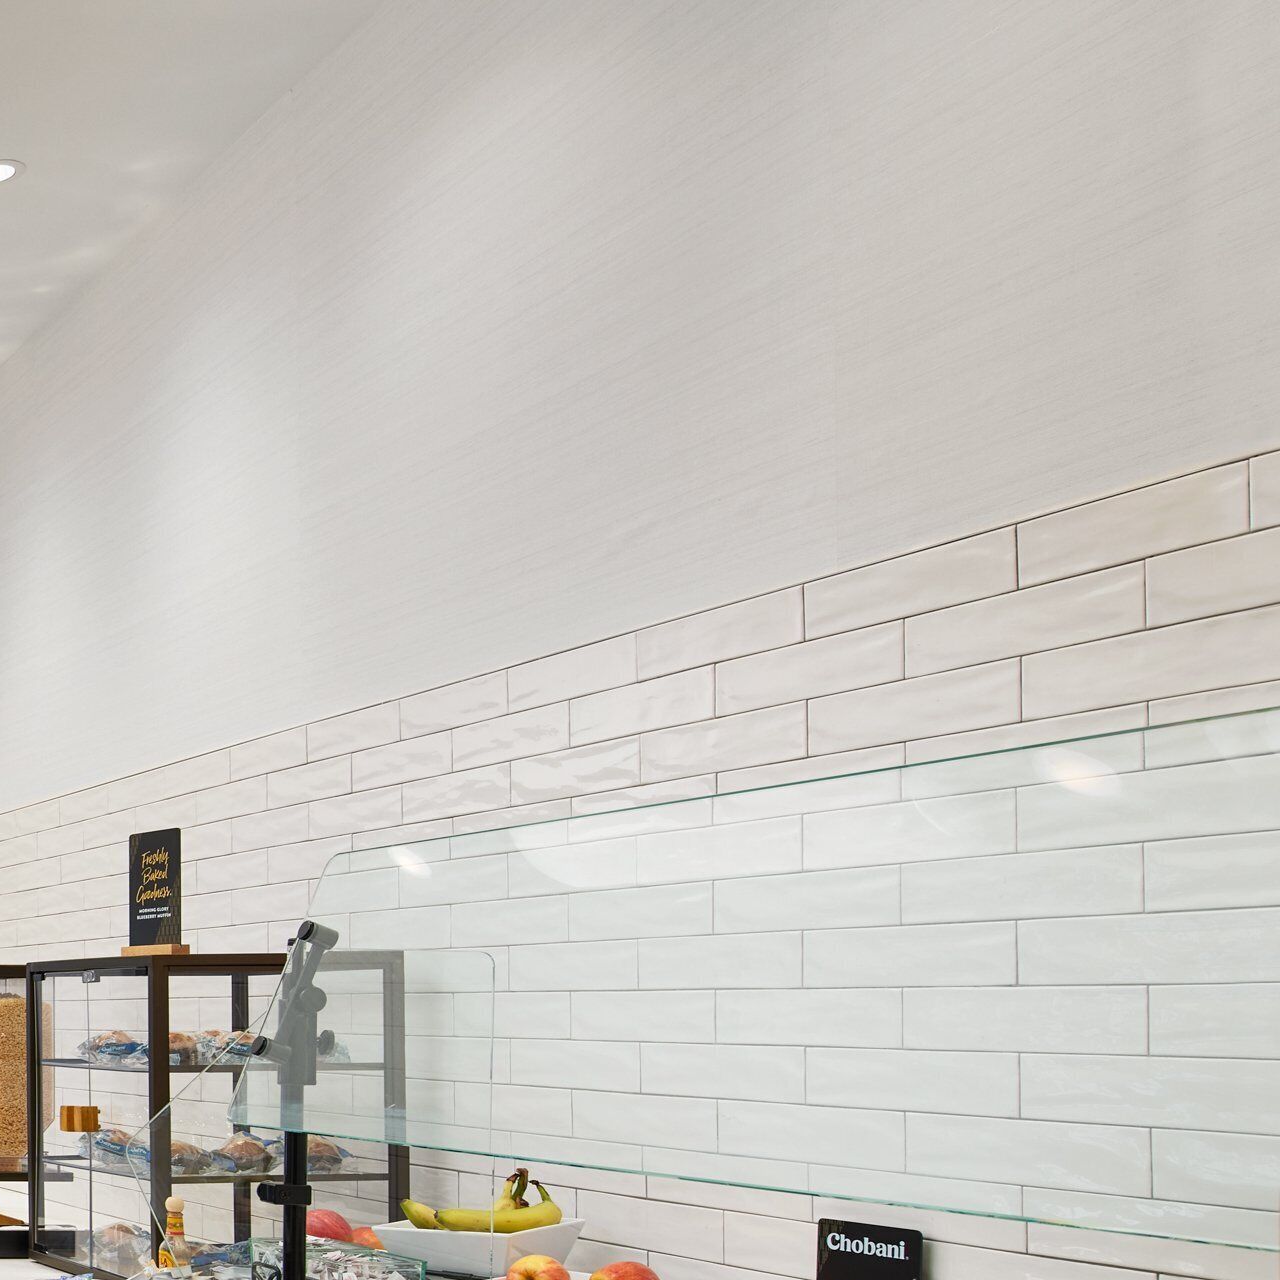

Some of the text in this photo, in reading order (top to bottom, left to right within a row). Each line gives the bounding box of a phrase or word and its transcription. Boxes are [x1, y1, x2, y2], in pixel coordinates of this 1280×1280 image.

[142, 847, 169, 868] Freshly
[142, 864, 168, 885] Baked
[136, 884, 172, 905] Goodness.
[826, 1232, 906, 1260] Chobani
